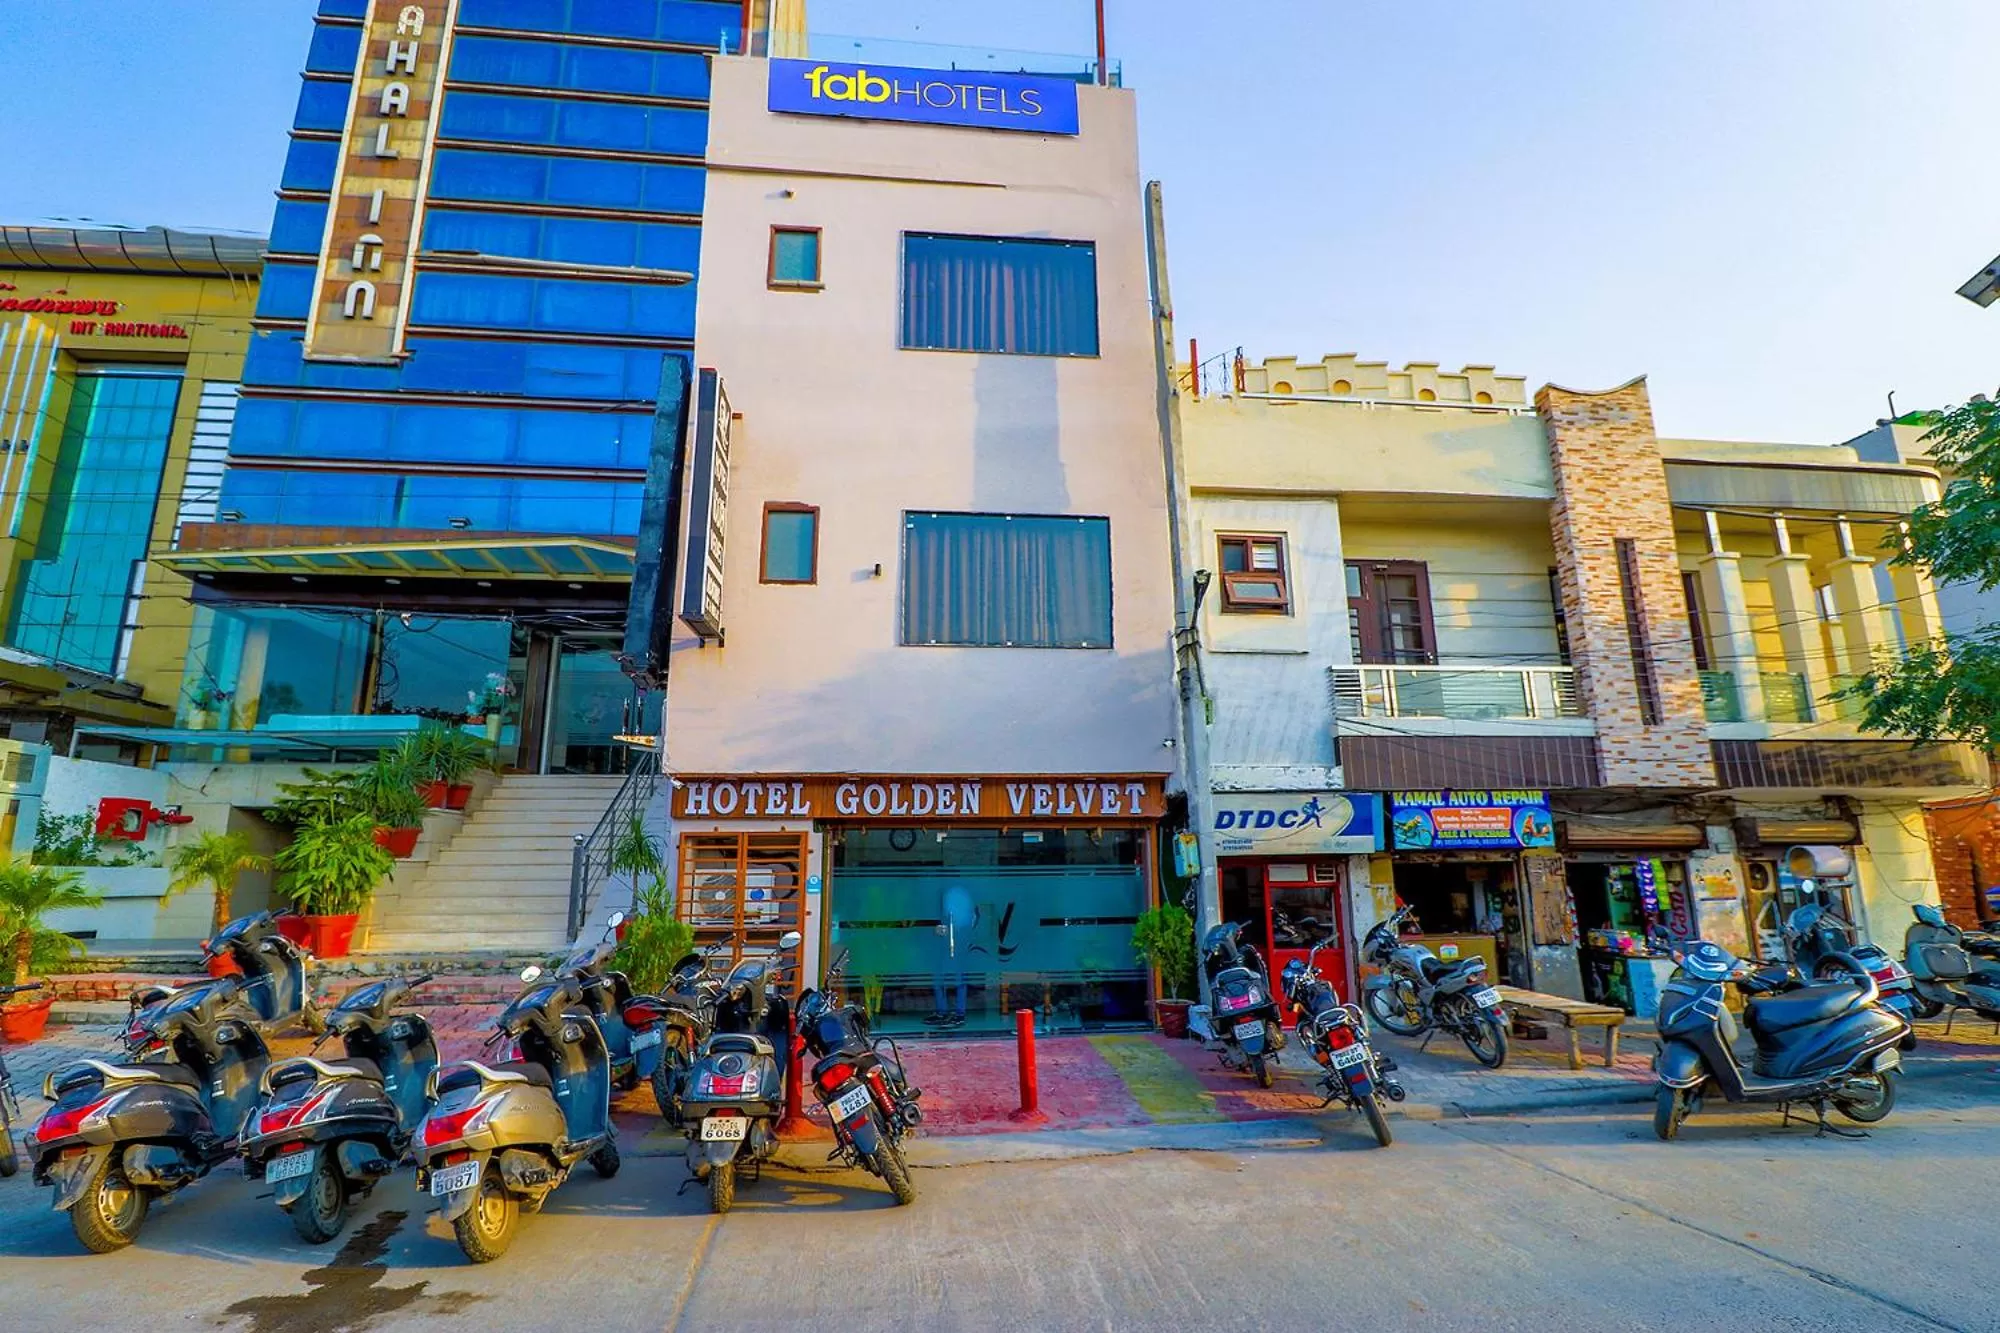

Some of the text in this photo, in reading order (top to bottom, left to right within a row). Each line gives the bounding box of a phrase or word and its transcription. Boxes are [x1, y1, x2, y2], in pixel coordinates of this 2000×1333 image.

[684, 782, 1146, 815] HOTEL GOLDEN VELVET
[1392, 789, 1545, 807] KAMAL AUTO REPAIR
[1214, 809, 1299, 830] DTDC
[1337, 1052, 1364, 1067] 6460
[705, 1129, 740, 1138] 6068
[436, 1172, 472, 1194] 5087
